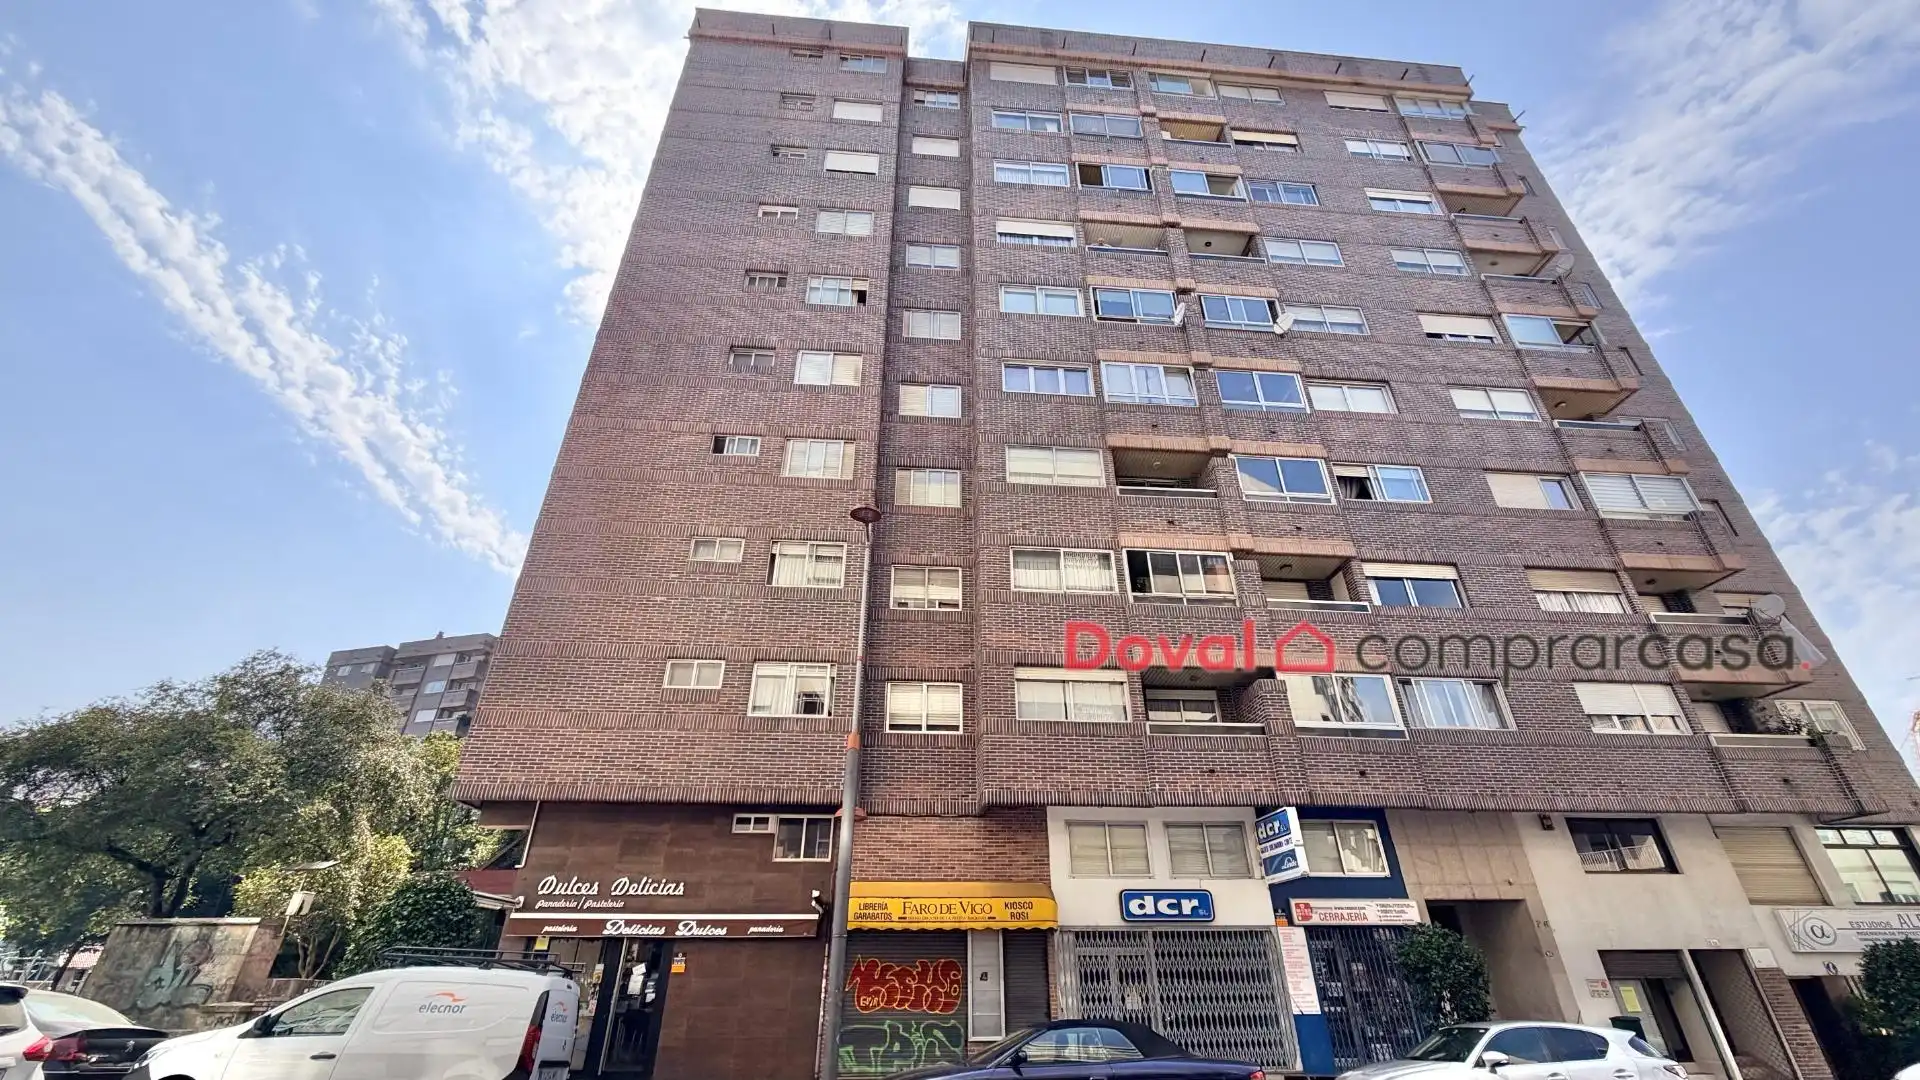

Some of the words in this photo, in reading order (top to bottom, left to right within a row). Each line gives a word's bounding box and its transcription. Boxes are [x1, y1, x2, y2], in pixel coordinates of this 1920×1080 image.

[1258, 819, 1280, 839] dcr
[538, 875, 599, 895] Dulces
[610, 876, 685, 896] Delicias
[858, 901, 889, 911] LIBRERÍA
[902, 901, 937, 915] FARO
[939, 903, 959, 915] DE
[958, 901, 993, 915] VIGO
[1004, 901, 1033, 910] KIOSCO
[1128, 895, 1199, 916] dcr
[853, 912, 892, 921] GARABATOS
[1010, 911, 1029, 920] ROSI
[1319, 910, 1369, 922] CERRAJERÍA
[602, 919, 666, 935] Delicias
[675, 920, 728, 935] Dulces
[1848, 920, 1894, 929] ESTUDIOS
[418, 1001, 467, 1014] elecnor
